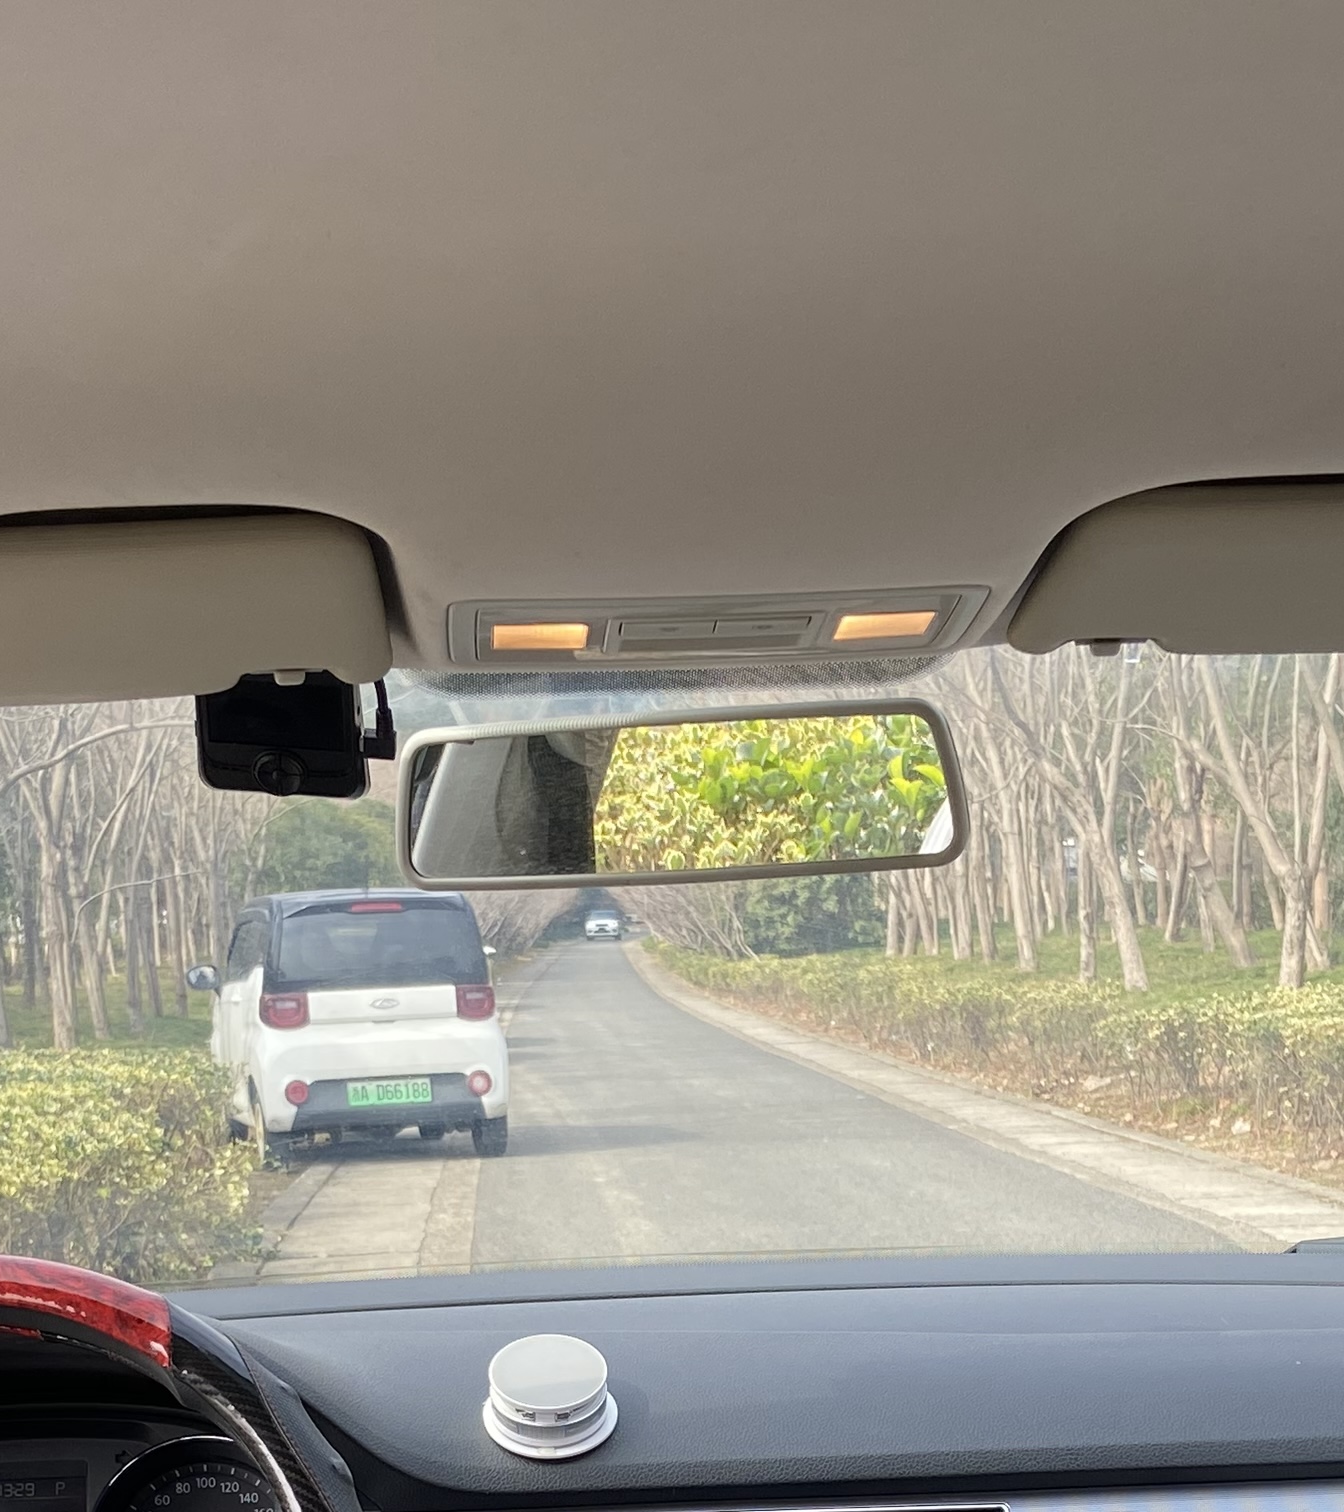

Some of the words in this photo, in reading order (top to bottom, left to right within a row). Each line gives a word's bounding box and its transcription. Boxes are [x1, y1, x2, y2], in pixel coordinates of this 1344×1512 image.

[56, 1482, 65, 1495] P
[175, 1482, 191, 1494] 80
[196, 1477, 216, 1489] 100
[219, 1481, 240, 1493] 120
[154, 1494, 171, 1506] 60
[239, 1492, 259, 1504] 140
